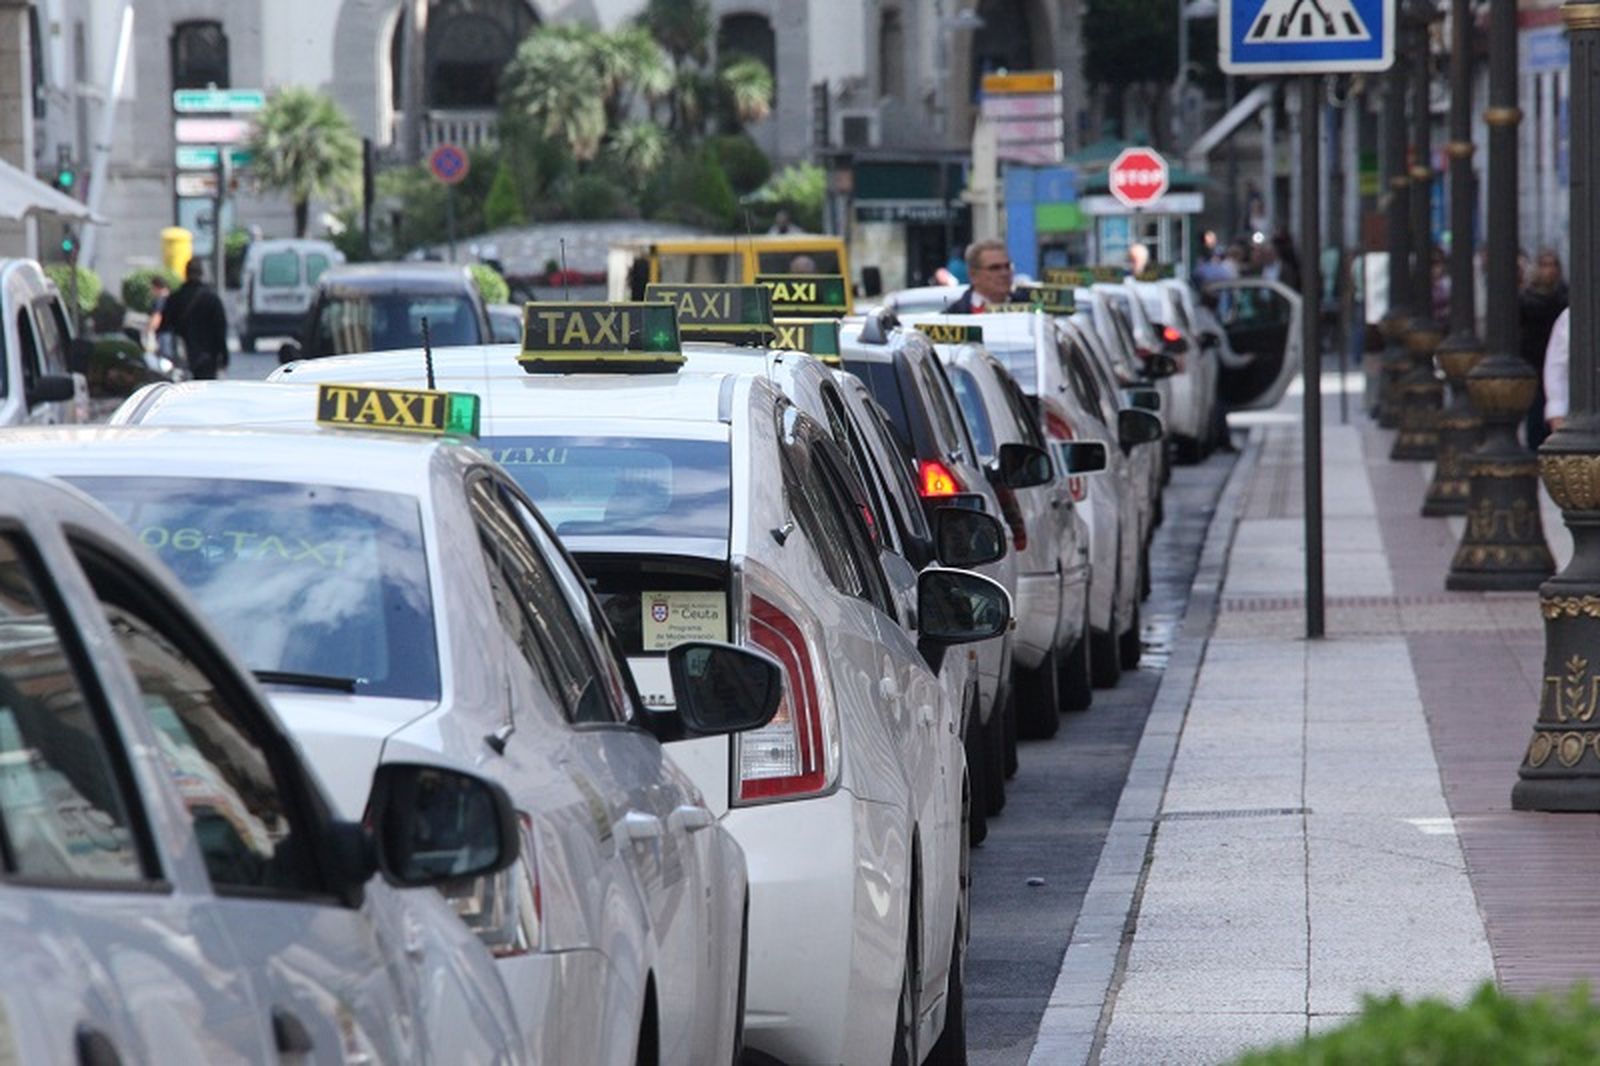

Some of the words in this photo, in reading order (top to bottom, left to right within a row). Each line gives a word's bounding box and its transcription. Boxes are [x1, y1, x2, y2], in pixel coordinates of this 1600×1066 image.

[1115, 169, 1162, 186] STOP
[657, 290, 730, 319] TAXI
[538, 310, 631, 345] TAXI
[326, 387, 439, 428] TAXI
[681, 609, 719, 620] Ceuta
